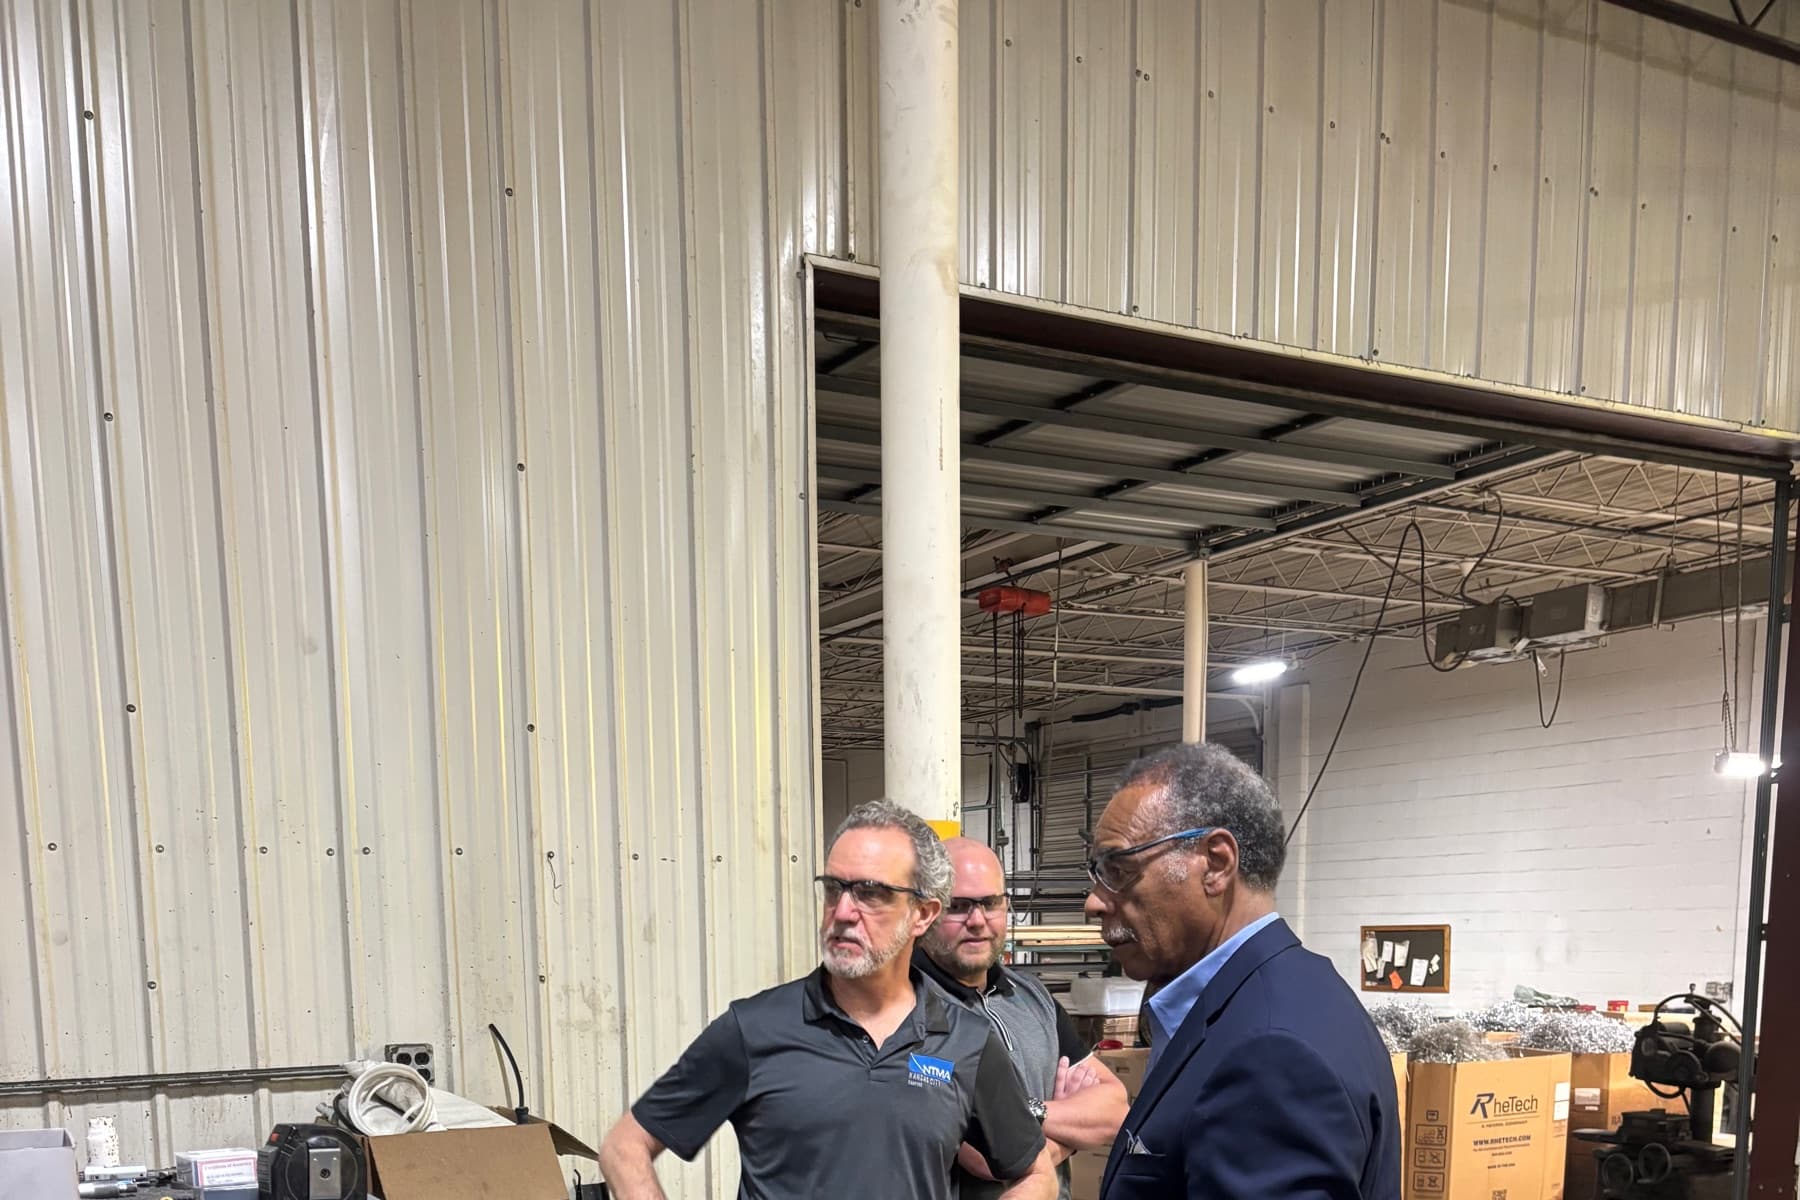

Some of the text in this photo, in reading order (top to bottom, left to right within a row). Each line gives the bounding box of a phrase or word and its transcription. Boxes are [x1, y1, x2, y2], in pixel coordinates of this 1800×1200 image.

[922, 1064, 951, 1081] NTMA
[1470, 1093, 1538, 1119] RheTech
[1473, 1135, 1531, 1146] WWW.RHETECH.COM
